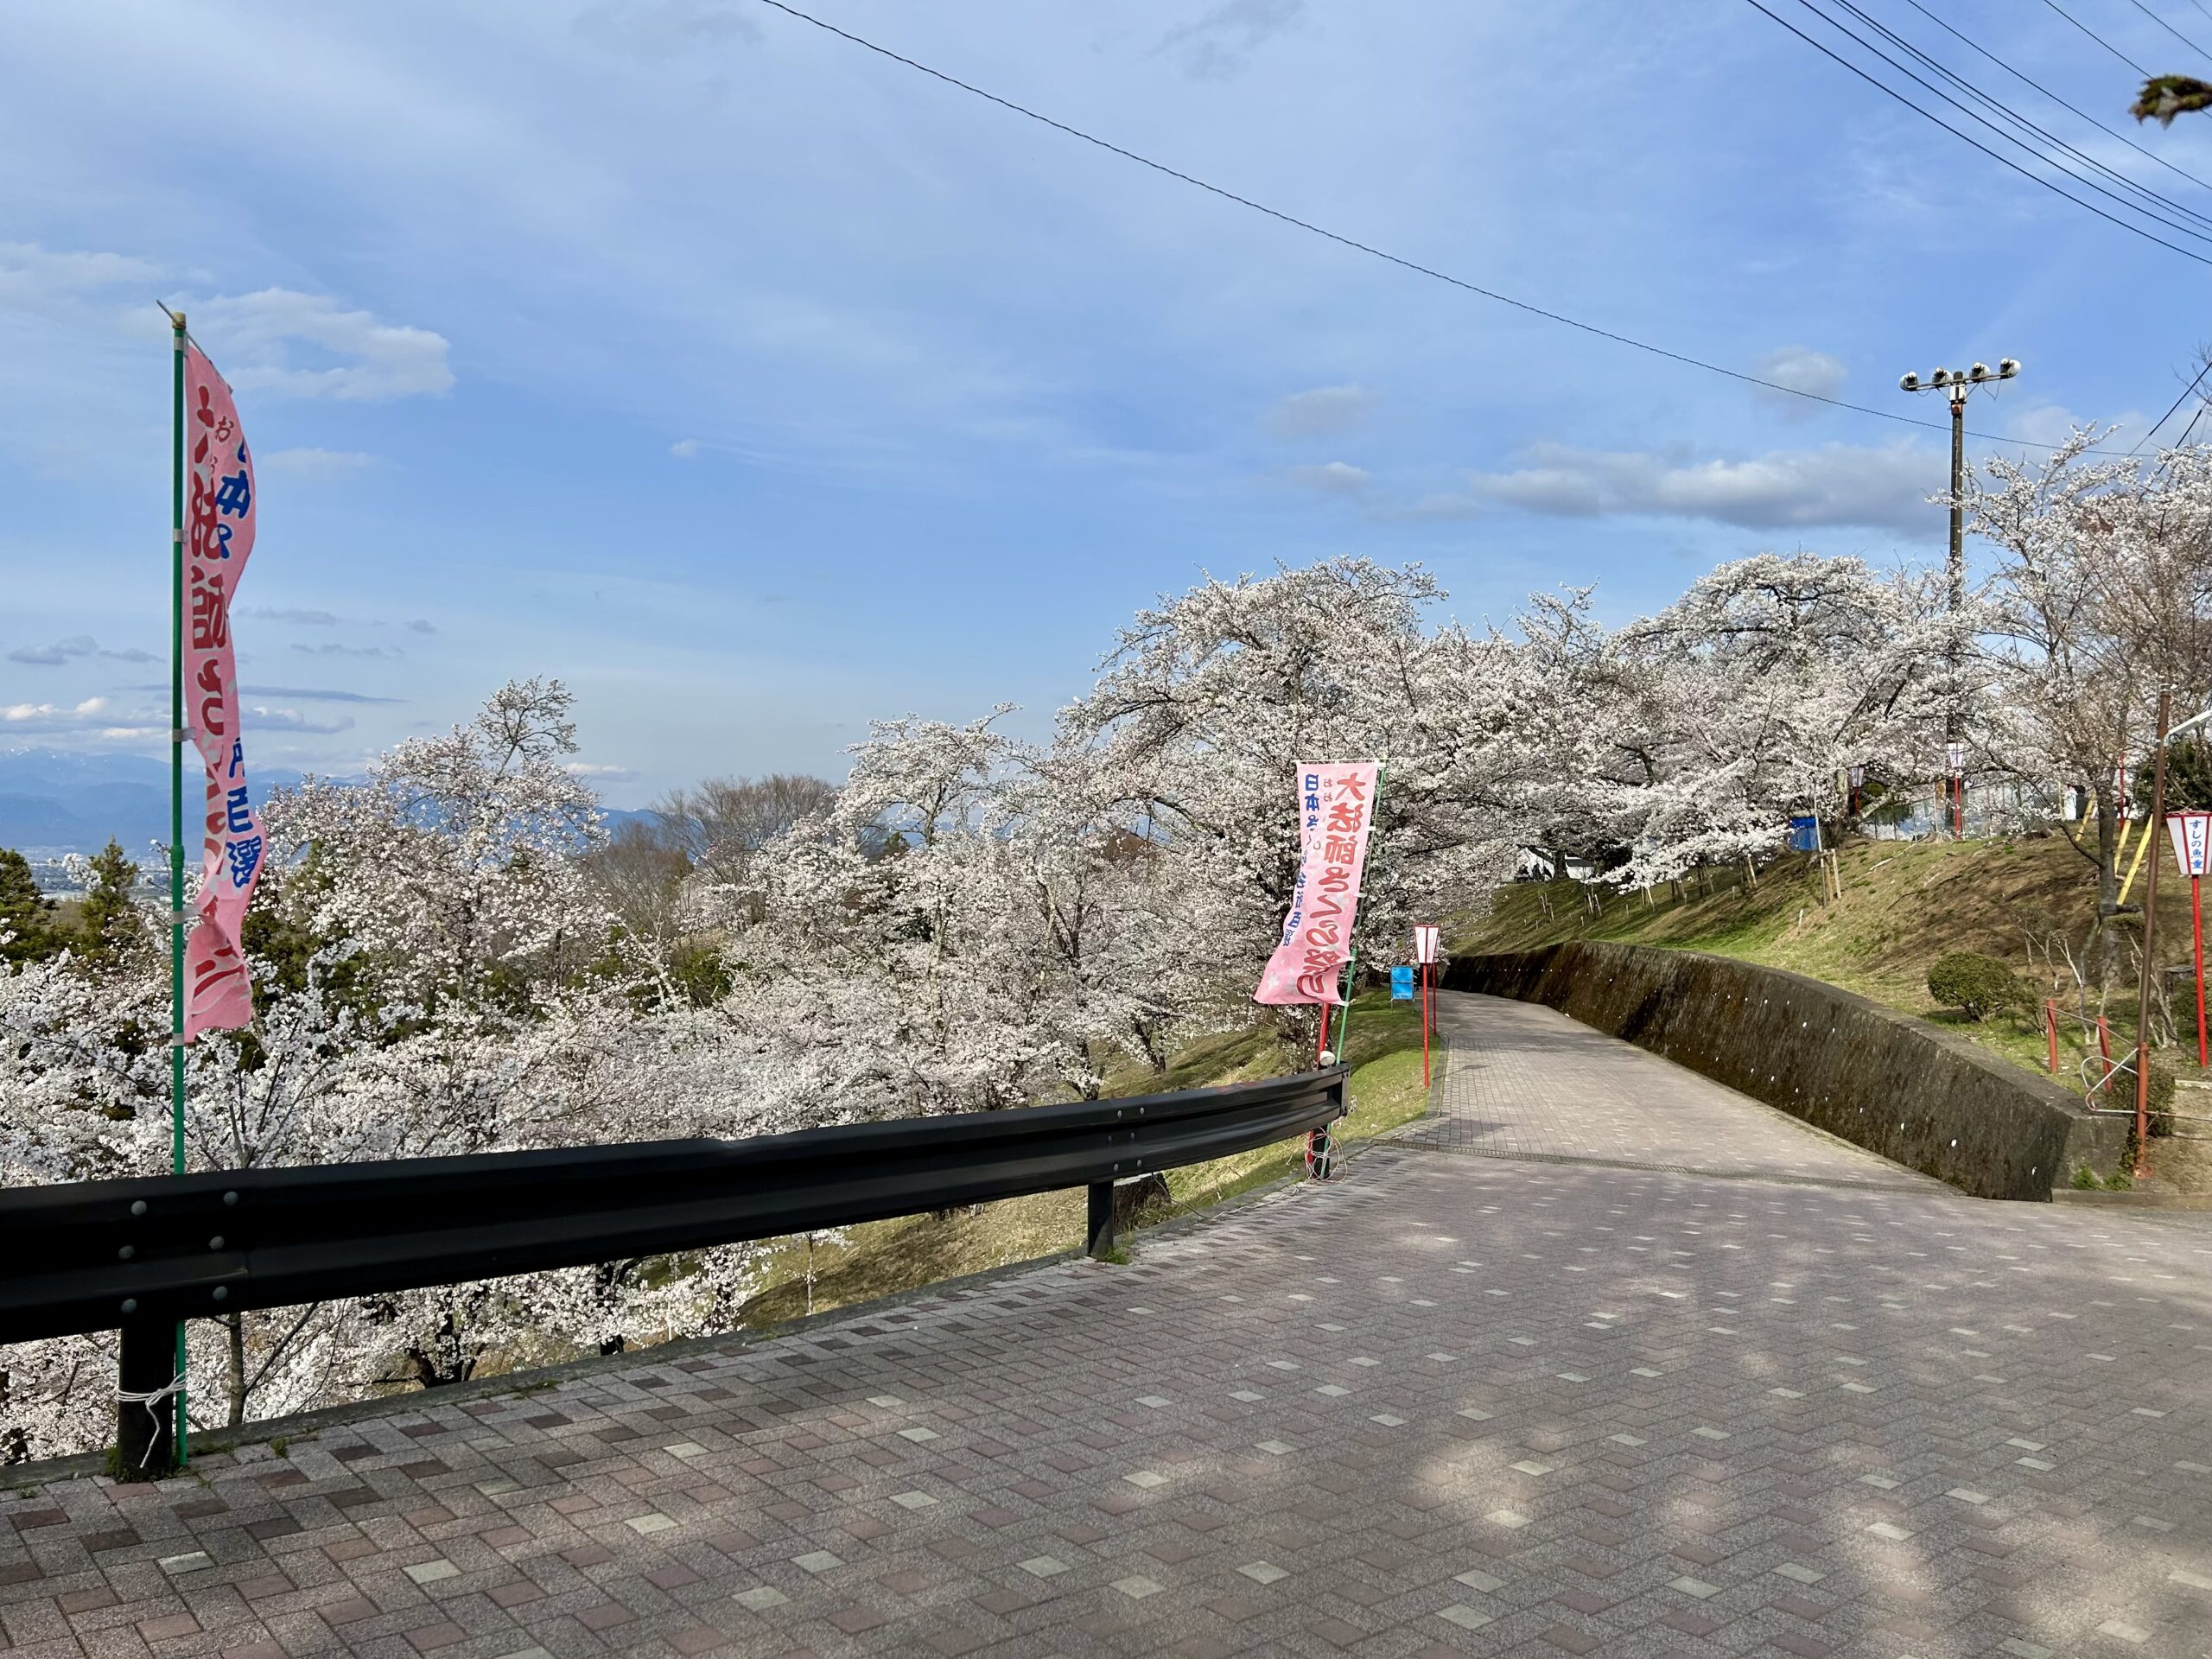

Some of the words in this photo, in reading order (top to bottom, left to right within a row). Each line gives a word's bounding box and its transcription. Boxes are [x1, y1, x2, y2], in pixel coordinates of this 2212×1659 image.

[2190, 819, 2203, 868] すしの魚重
